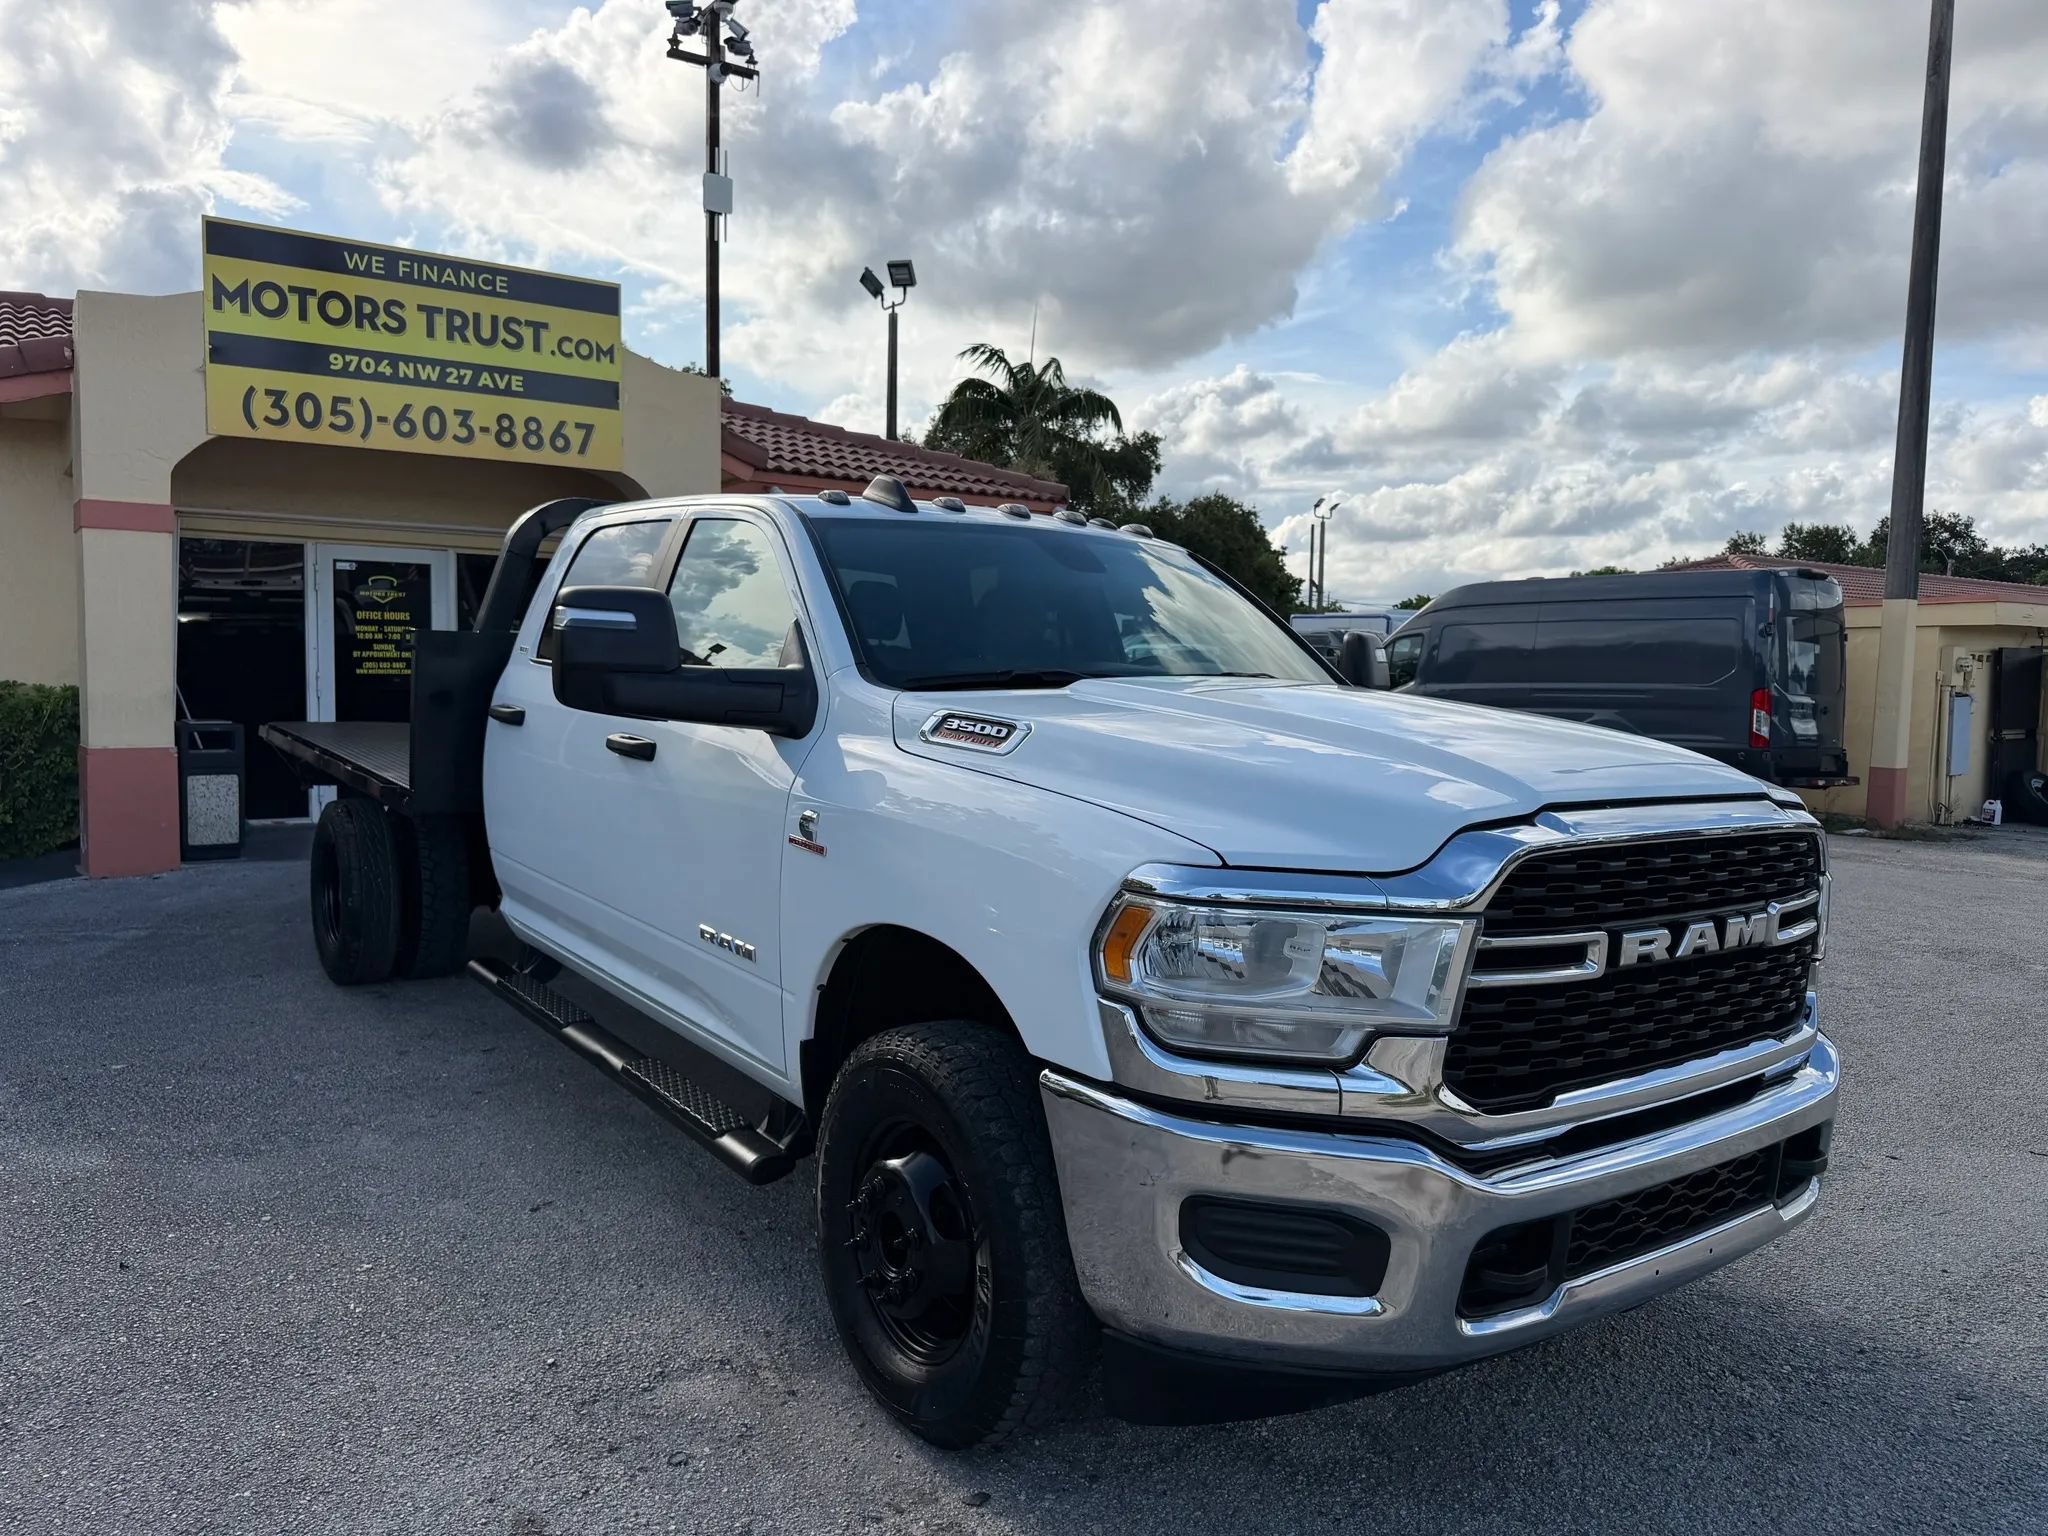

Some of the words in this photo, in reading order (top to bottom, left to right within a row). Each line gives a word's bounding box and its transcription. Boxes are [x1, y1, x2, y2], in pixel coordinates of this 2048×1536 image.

[343, 251, 386, 275] WE
[398, 259, 510, 294] FINANCE
[212, 272, 408, 337] MOTORS
[416, 302, 616, 365] TRUST.COM
[328, 352, 394, 378] 9704
[398, 360, 441, 383] NW
[445, 367, 473, 386] 27
[477, 372, 525, 392] AVE
[241, 384, 597, 457] (305)-603-8867
[357, 611, 382, 620] OFFICE
[384, 612, 410, 620] HOURS
[373, 643, 396, 651] SUNDAY
[943, 718, 1009, 738] 3500
[699, 924, 757, 963] RAM
[1619, 911, 1769, 968] RAM
